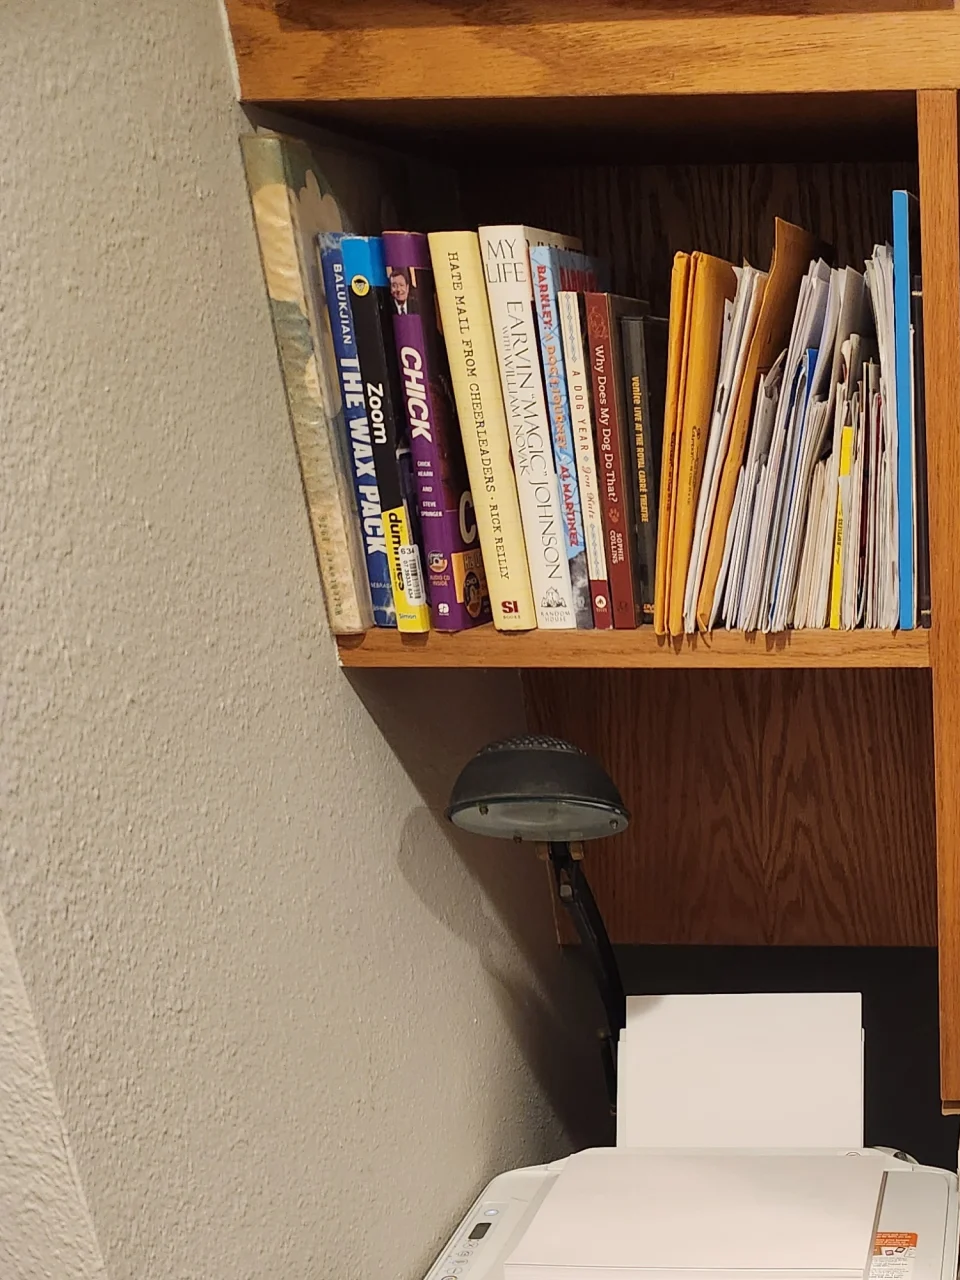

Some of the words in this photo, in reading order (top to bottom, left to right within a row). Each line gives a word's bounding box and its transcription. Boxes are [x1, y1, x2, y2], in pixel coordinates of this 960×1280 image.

[487, 239, 516, 260] MY
[447, 252, 464, 291] HATE
[486, 262, 526, 284] LIFE
[332, 263, 352, 345] BALUKJIAN
[454, 294, 470, 335] MAIL
[502, 326, 511, 352] WITH
[462, 339, 478, 378] FROM
[594, 345, 605, 374] Why
[340, 355, 366, 410] THE
[400, 346, 433, 444] CHICK
[504, 353, 521, 418] WILLIAM
[573, 385, 585, 411] DOG
[597, 376, 608, 405] Does
[366, 382, 387, 444] Zoom
[551, 389, 568, 450] JOURNEY
[600, 407, 611, 427] My
[633, 406, 643, 422] LIVE
[634, 424, 643, 432] AT
[348, 416, 376, 478] WAX
[469, 382, 496, 492] CHEERLEADERS
[506, 301, 534, 389] EARVIN
[529, 479, 563, 580] JOHNSON
[513, 424, 530, 476] NOVAK
[577, 418, 590, 452] YEAR
[601, 428, 612, 451] Dog
[635, 432, 644, 443] THE
[416, 460, 431, 468] CHICK
[604, 453, 614, 469] Do
[636, 445, 646, 469] ROYAL
[559, 465, 569, 482] AL
[605, 470, 618, 503] That?
[638, 470, 648, 495] CARRÉ
[358, 485, 388, 555] PACK
[489, 503, 502, 534] RICK
[561, 483, 580, 548] MARTINEZ
[640, 494, 649, 523] THEATRE
[495, 537, 510, 580] REILLY
[608, 529, 618, 565] COLLINS
[616, 532, 625, 562] SOPHIE
[501, 600, 518, 614] SI
